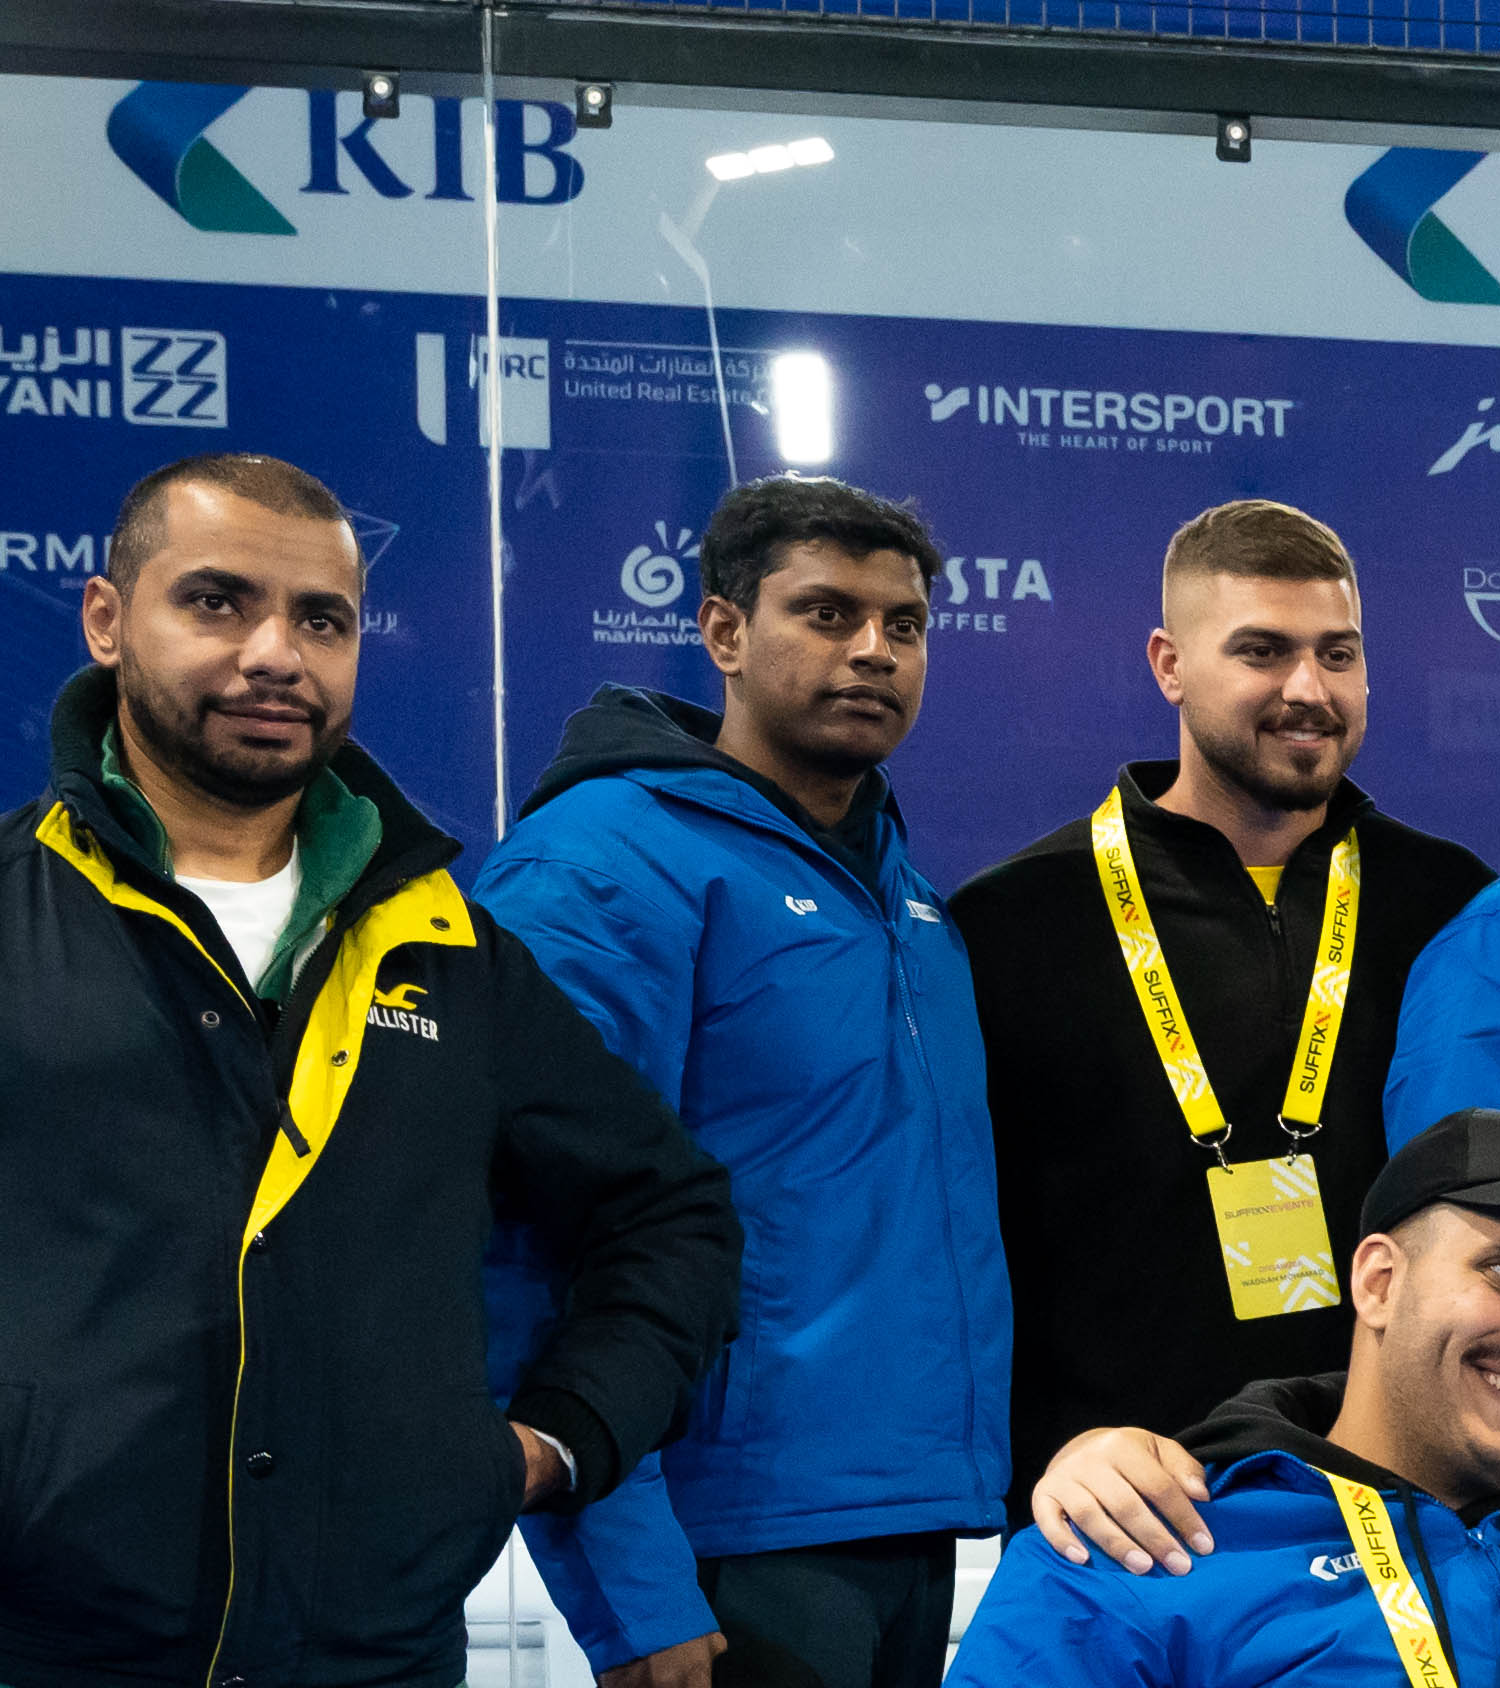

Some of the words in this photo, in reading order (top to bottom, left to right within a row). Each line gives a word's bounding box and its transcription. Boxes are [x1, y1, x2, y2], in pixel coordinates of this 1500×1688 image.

[298, 87, 586, 207] KIB
[564, 380, 632, 401] United
[637, 382, 682, 402] Real
[978, 385, 1294, 437] INTERSPORT
[1017, 432, 1050, 448] THE
[1060, 434, 1119, 450] HEART
[1127, 437, 1149, 451] OF
[1156, 437, 1214, 454] SPORT
[945, 556, 1054, 606] STA
[926, 612, 1007, 633] FFEE
[1106, 847, 1136, 909] SUFFIX
[1329, 897, 1352, 964] SUFFIX
[367, 1005, 439, 1041] OLLISTER
[1144, 969, 1181, 1039] SUFFIX
[1300, 1023, 1329, 1093] SUFFIX
[1356, 1499, 1398, 1580] SUFFIX
